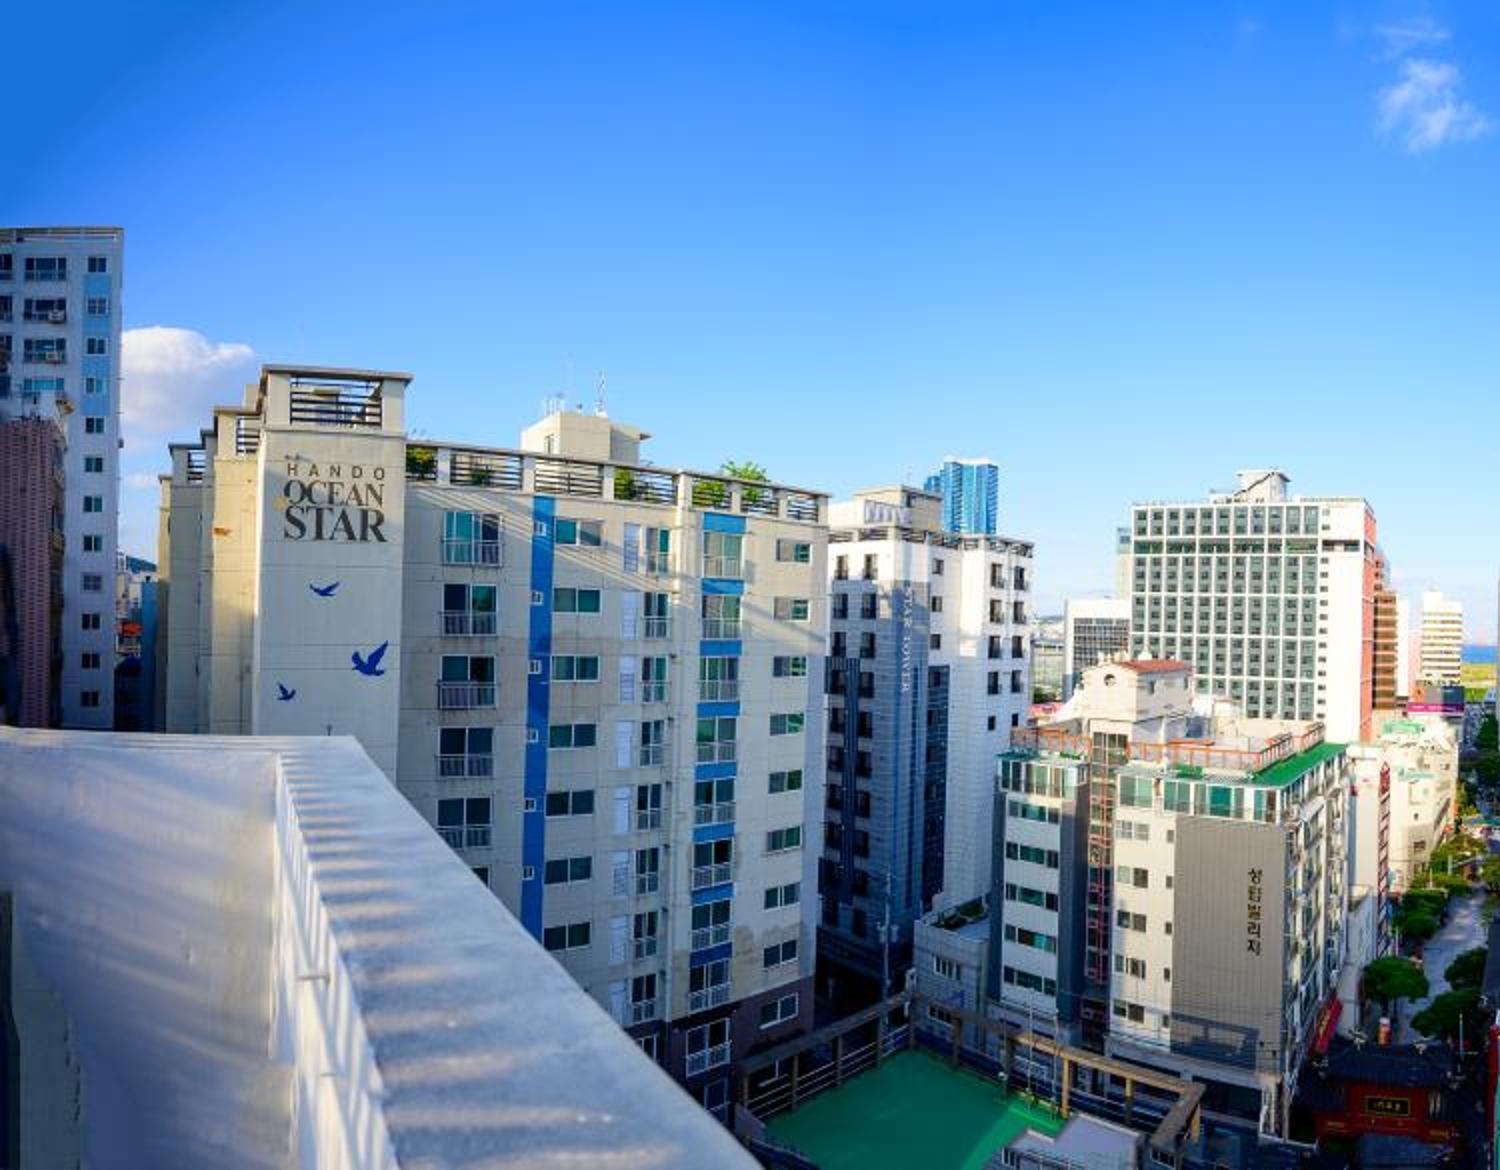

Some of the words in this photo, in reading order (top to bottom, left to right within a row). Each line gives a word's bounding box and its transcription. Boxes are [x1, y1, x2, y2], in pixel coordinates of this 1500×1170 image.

[287, 463, 385, 480] HANDO
[283, 480, 384, 507] OCEAN
[284, 505, 387, 542] STAR
